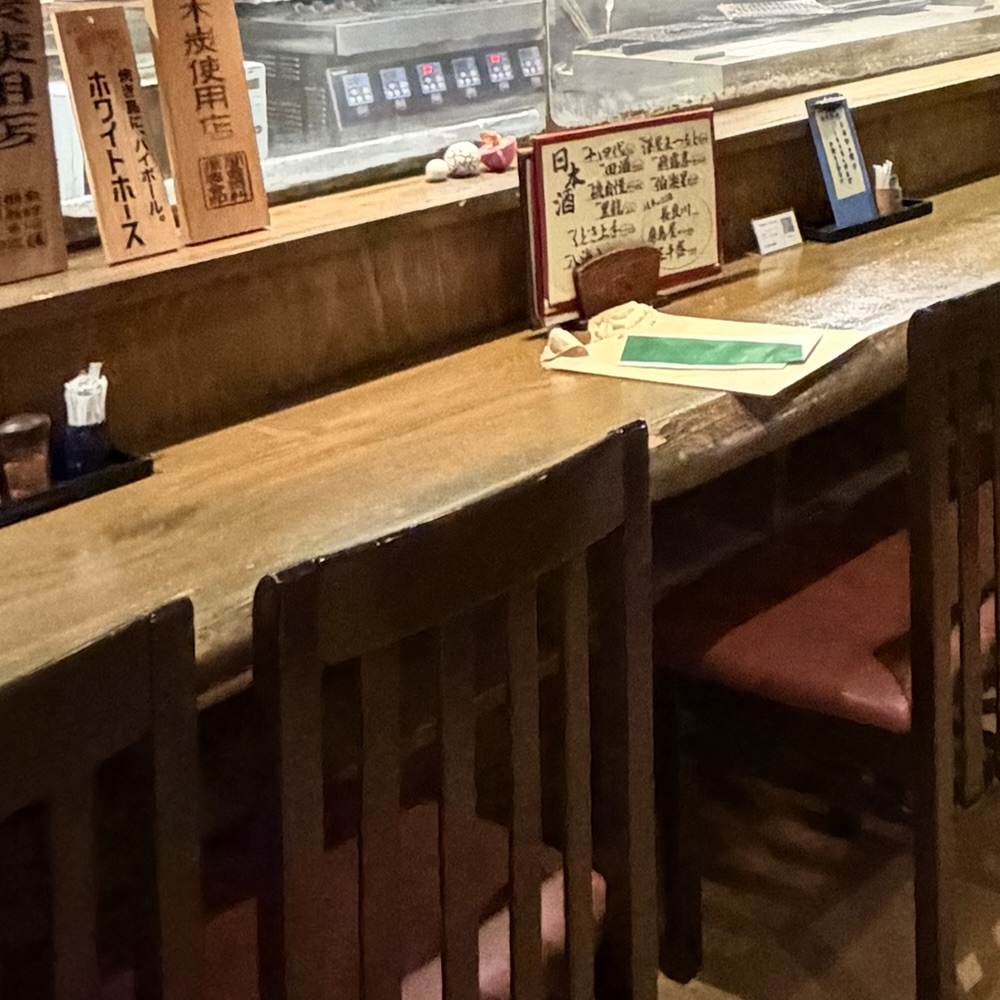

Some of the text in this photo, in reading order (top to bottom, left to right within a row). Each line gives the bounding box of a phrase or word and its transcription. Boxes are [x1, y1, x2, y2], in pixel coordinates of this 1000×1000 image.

[87, 70, 146, 249] ホワイトホース
[552, 146, 586, 217] 日本酒
